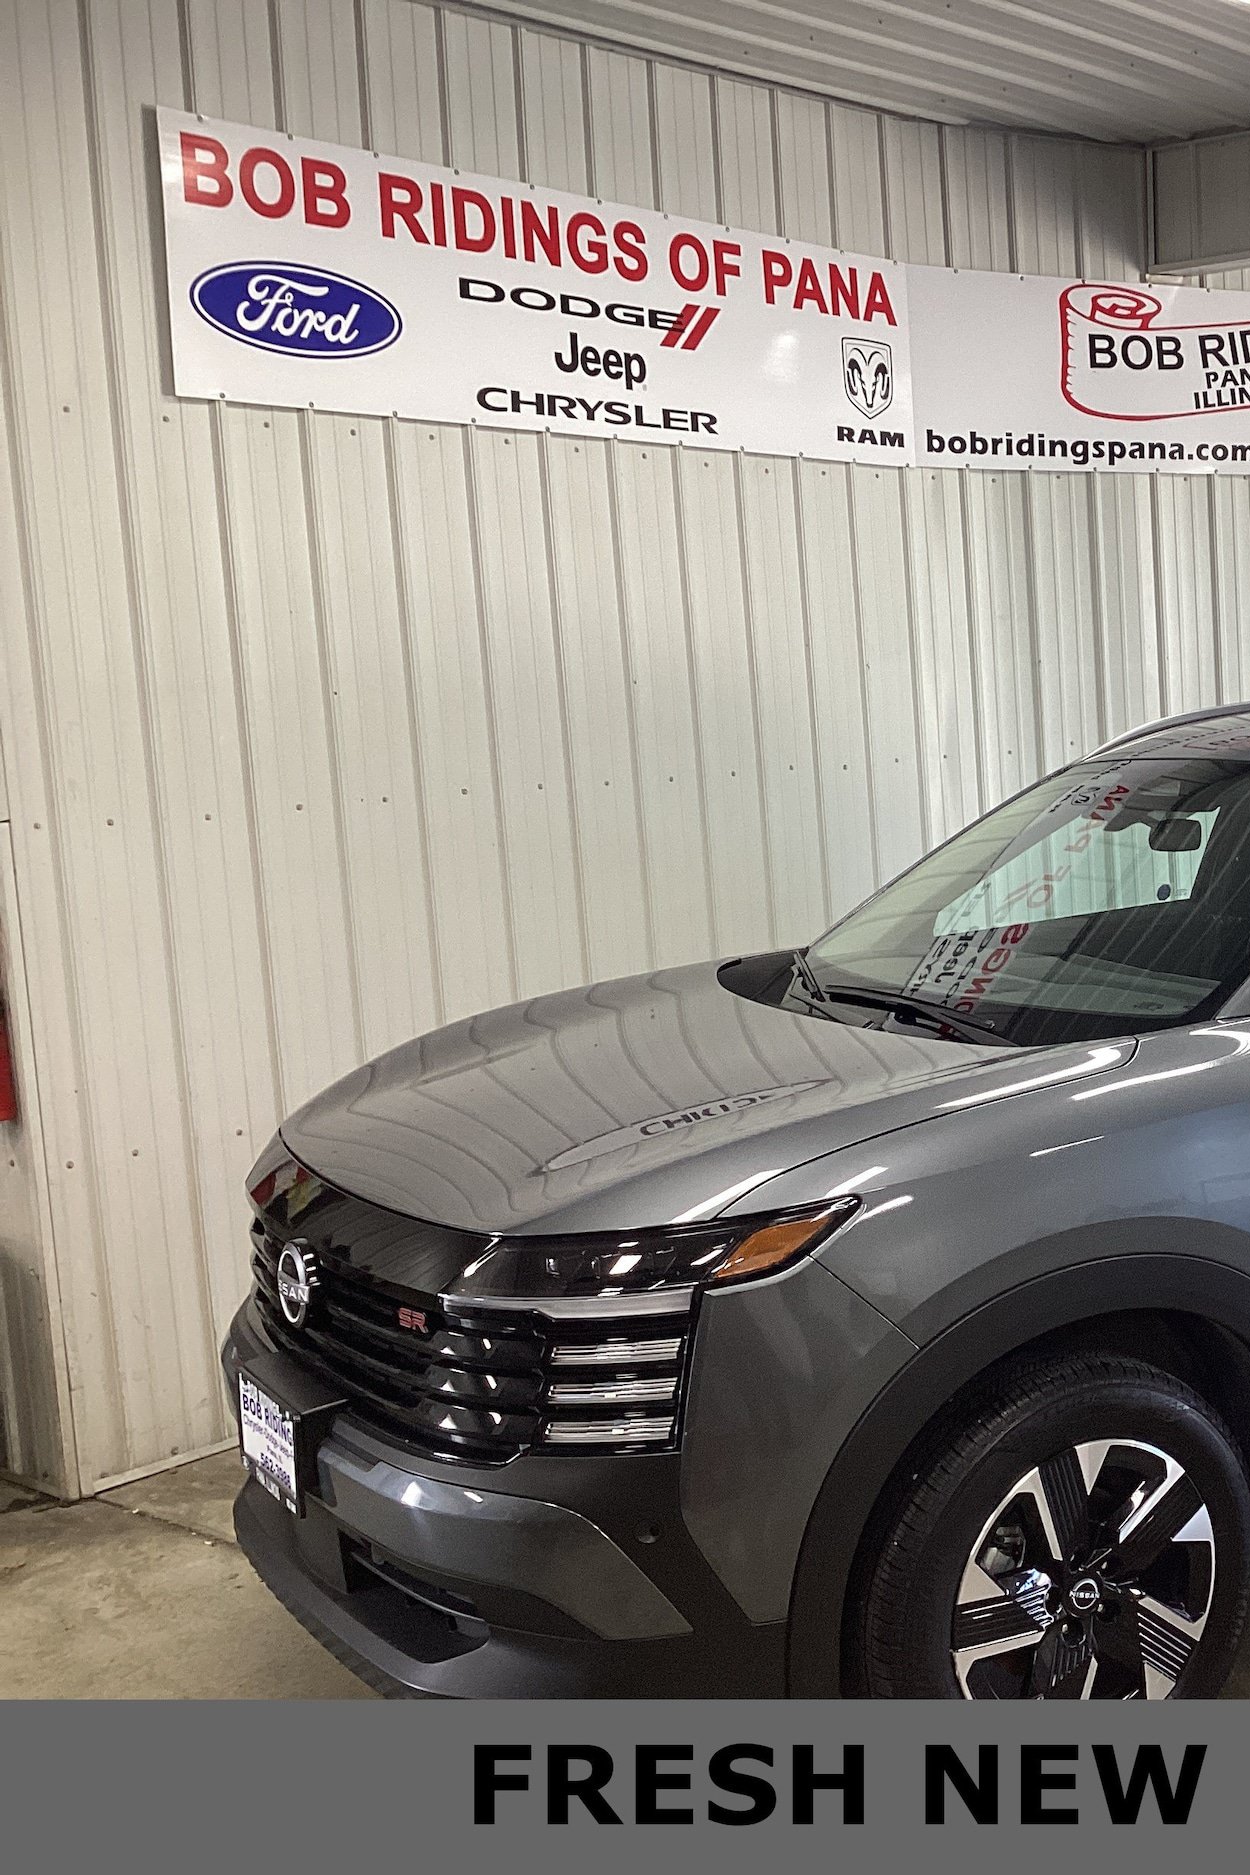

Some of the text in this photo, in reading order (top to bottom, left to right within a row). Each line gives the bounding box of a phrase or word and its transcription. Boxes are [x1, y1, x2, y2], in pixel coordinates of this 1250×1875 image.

[179, 132, 898, 326] BOB RIDINGS OF PANA
[235, 273, 361, 344] Ford
[458, 277, 687, 333] DODGE
[554, 332, 647, 390] Jeep
[1088, 333, 1185, 371] BOB
[476, 387, 719, 435] CHRYSLER
[837, 425, 905, 448] RAM
[398, 1307, 429, 1334] SR
[242, 1393, 263, 1421] BOB
